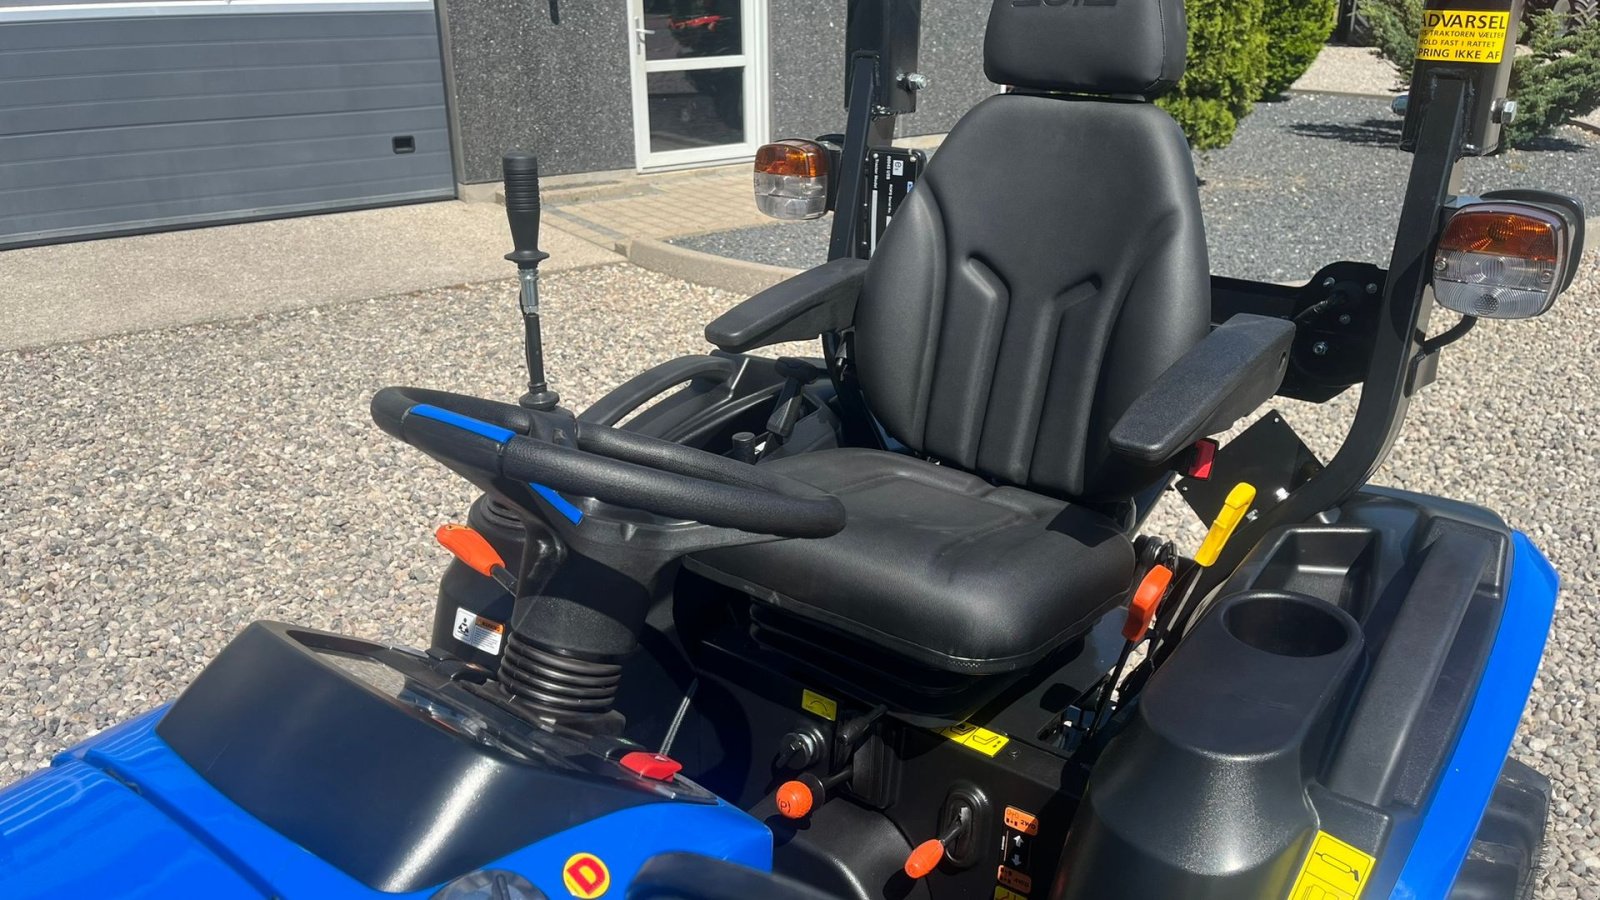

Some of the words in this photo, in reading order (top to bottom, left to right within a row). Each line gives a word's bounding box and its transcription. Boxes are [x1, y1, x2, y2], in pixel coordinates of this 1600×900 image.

[1421, 13, 1505, 29] ADVARSEL
[1430, 30, 1475, 38] TRAKTOREN
[1440, 39, 1459, 47] FAST
[1466, 40, 1496, 48] RATTET
[1454, 49, 1481, 59] IKKE
[1485, 50, 1501, 60] AF
[1020, 819, 1036, 830] 2WD
